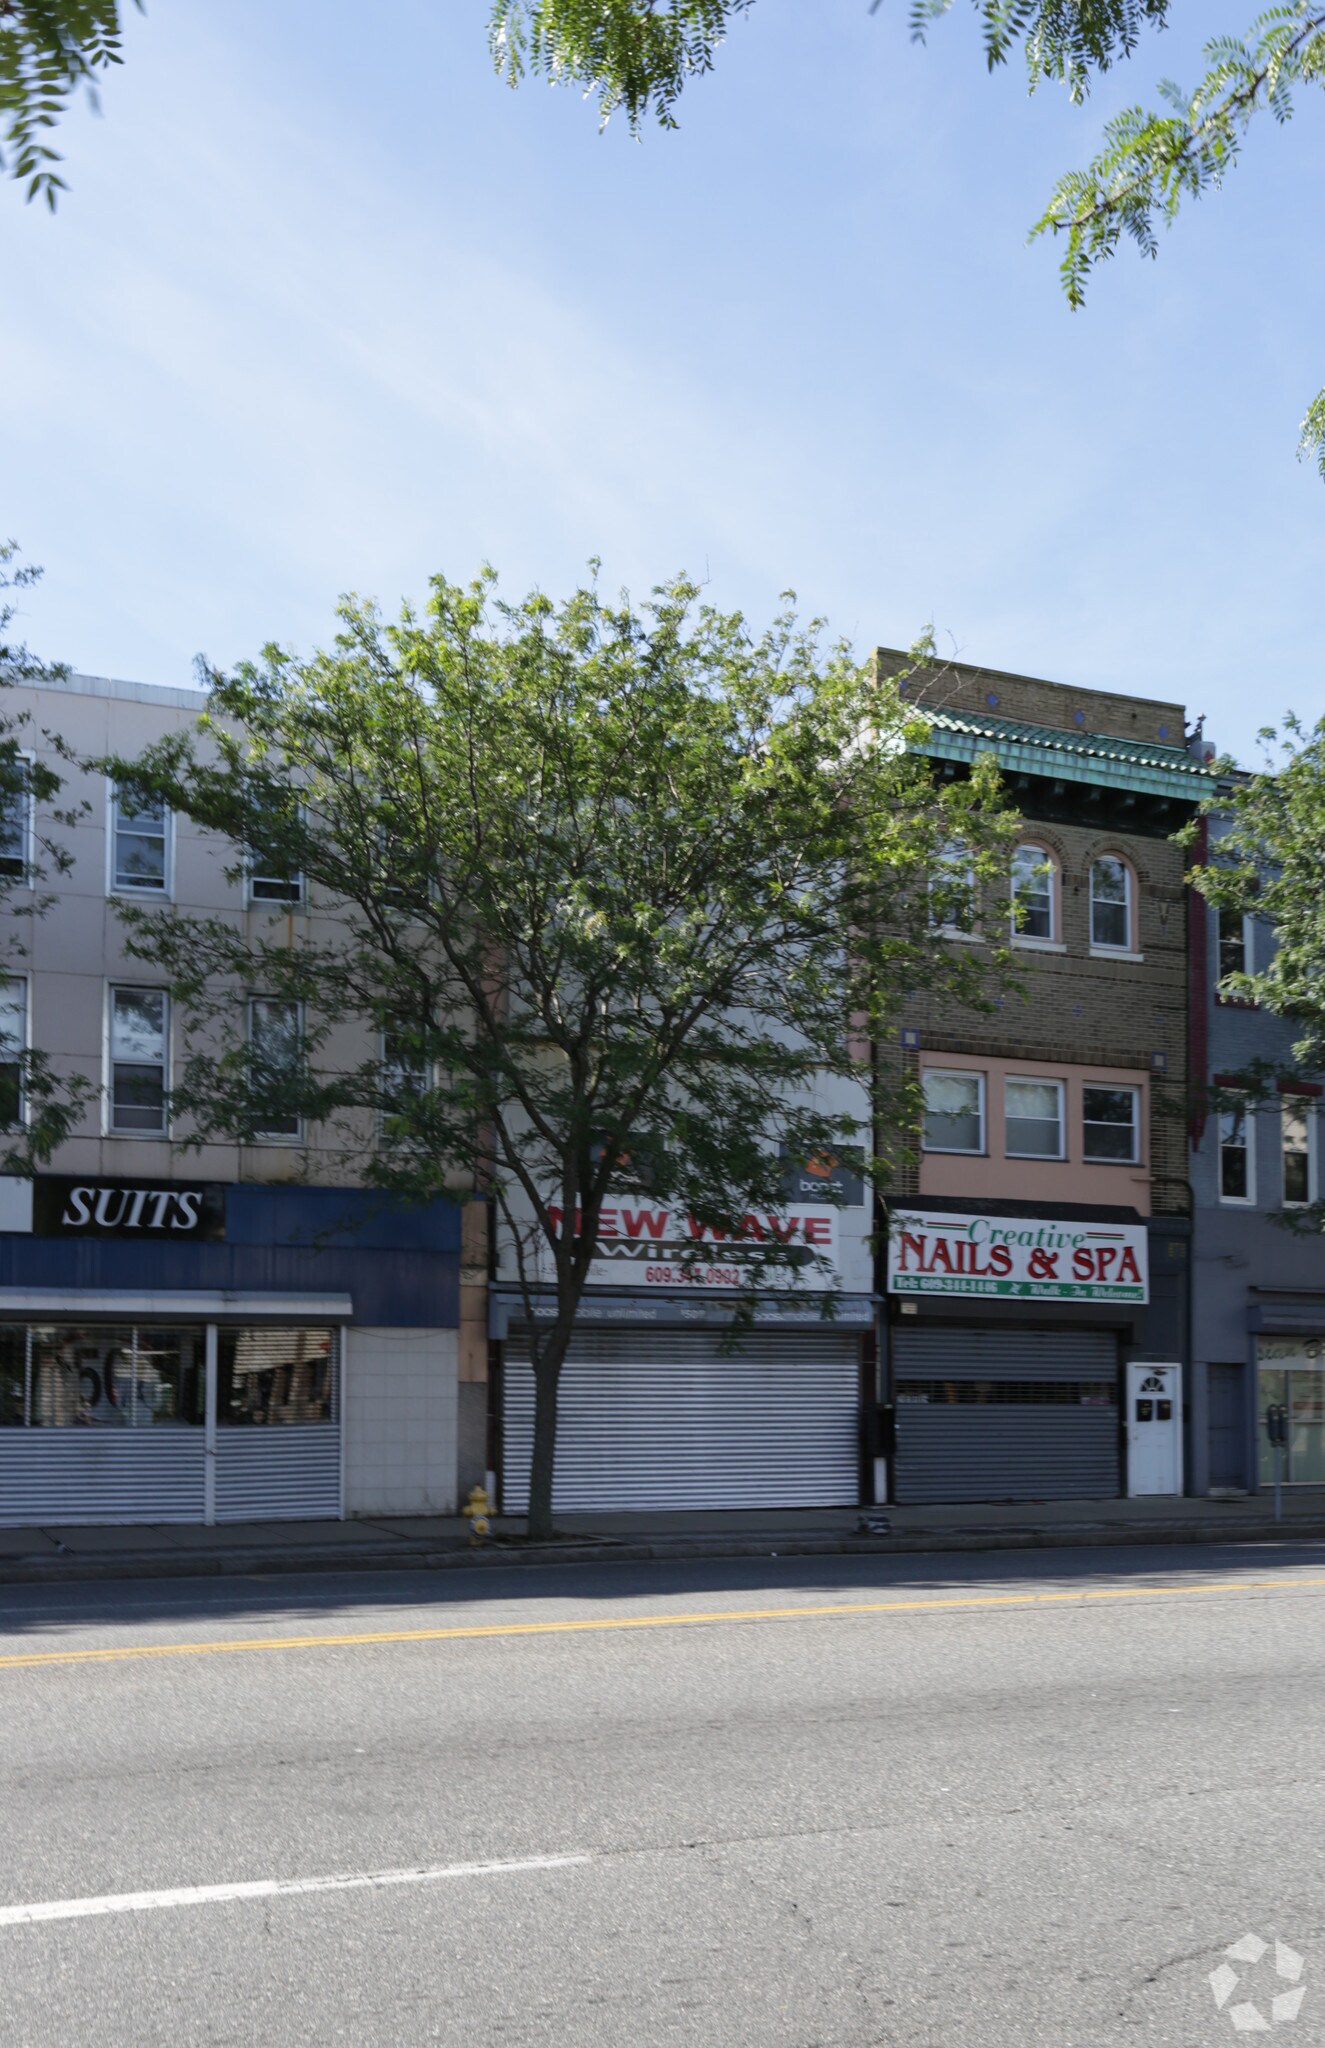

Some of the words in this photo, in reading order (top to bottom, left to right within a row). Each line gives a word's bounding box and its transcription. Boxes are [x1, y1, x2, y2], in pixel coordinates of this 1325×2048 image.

[62, 1187, 203, 1230] SUITS
[968, 1219, 1087, 1250] Creative
[897, 1231, 1013, 1277] NAILS
[1027, 1247, 1059, 1280] &
[1072, 1246, 1143, 1283] SPA
